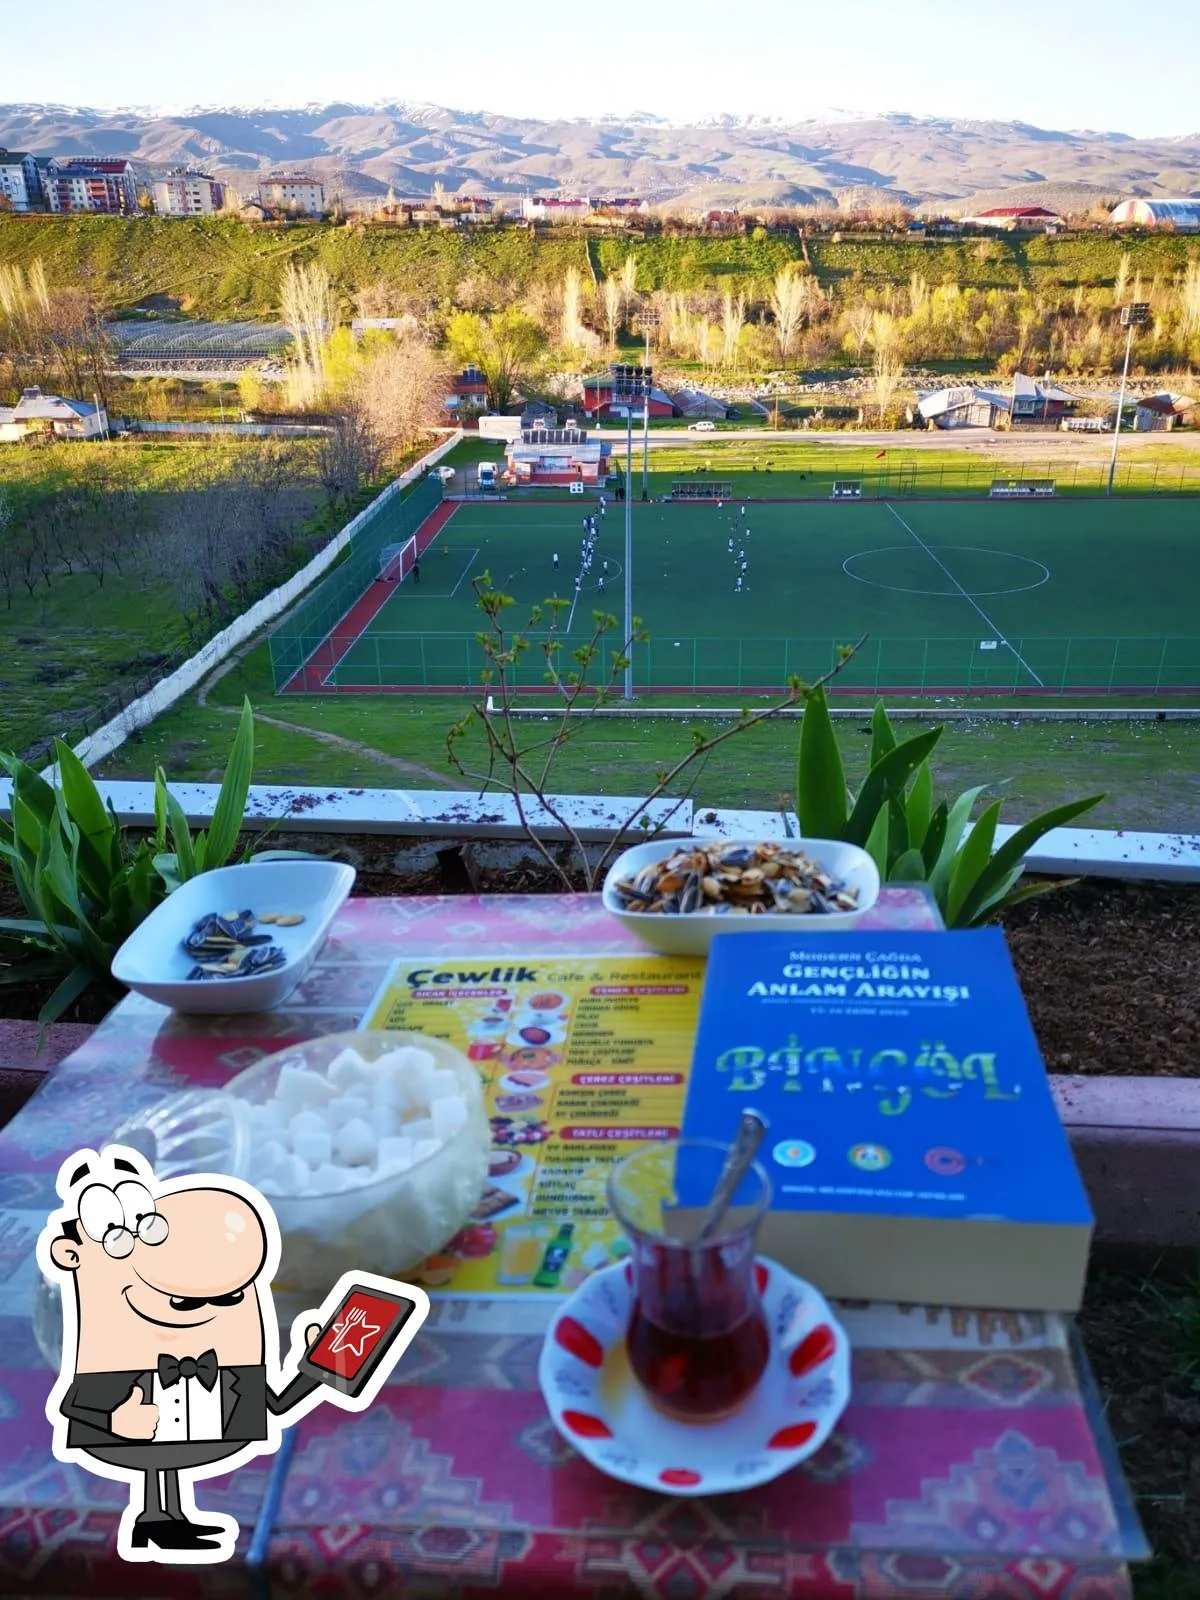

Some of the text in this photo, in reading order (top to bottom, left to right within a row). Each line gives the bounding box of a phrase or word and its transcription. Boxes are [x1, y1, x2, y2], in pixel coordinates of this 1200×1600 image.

[407, 967, 537, 988] Çewlik
[783, 963, 930, 981] GENÇLİĞİN
[747, 981, 970, 1001] ANLAM ARAYIŞI
[617, 1073, 676, 1084] ÇEŞİTLERİ
[715, 1032, 1022, 1116] BİNGÖL
[606, 1127, 669, 1139] ÇEŞİTLERİ
